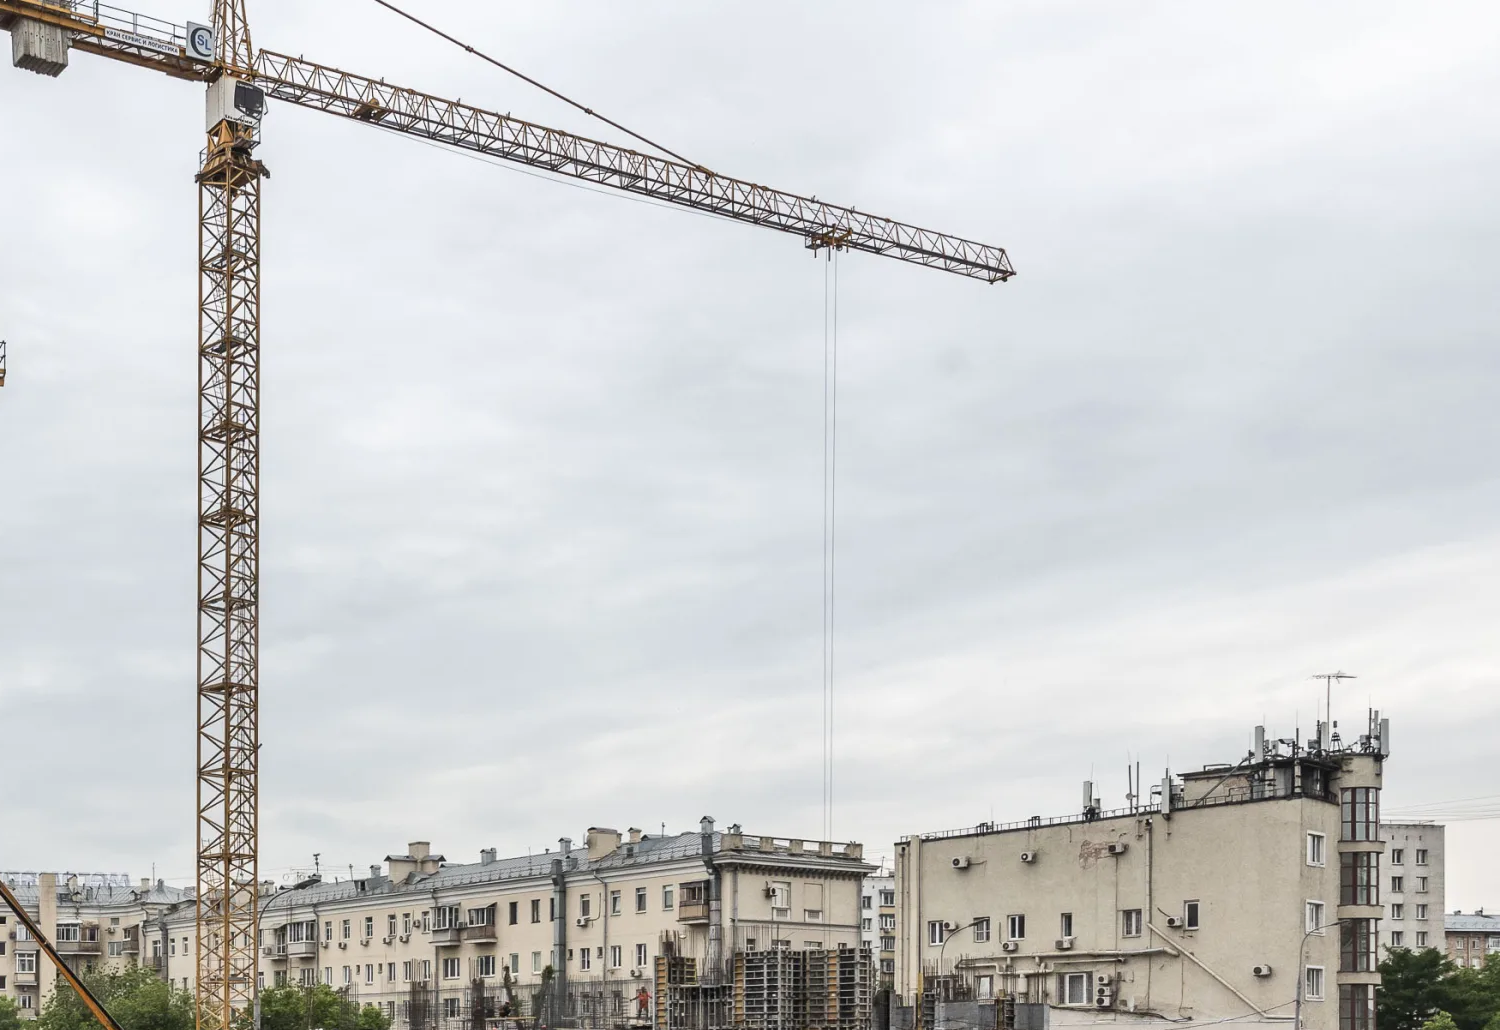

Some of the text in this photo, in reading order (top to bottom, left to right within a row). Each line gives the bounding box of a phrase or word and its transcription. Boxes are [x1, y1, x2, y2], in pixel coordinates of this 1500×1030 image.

[106, 29, 121, 39] КРАН
[121, 34, 142, 45] СЕРВИС
[147, 40, 179, 54] ЛОГИСТИКА
